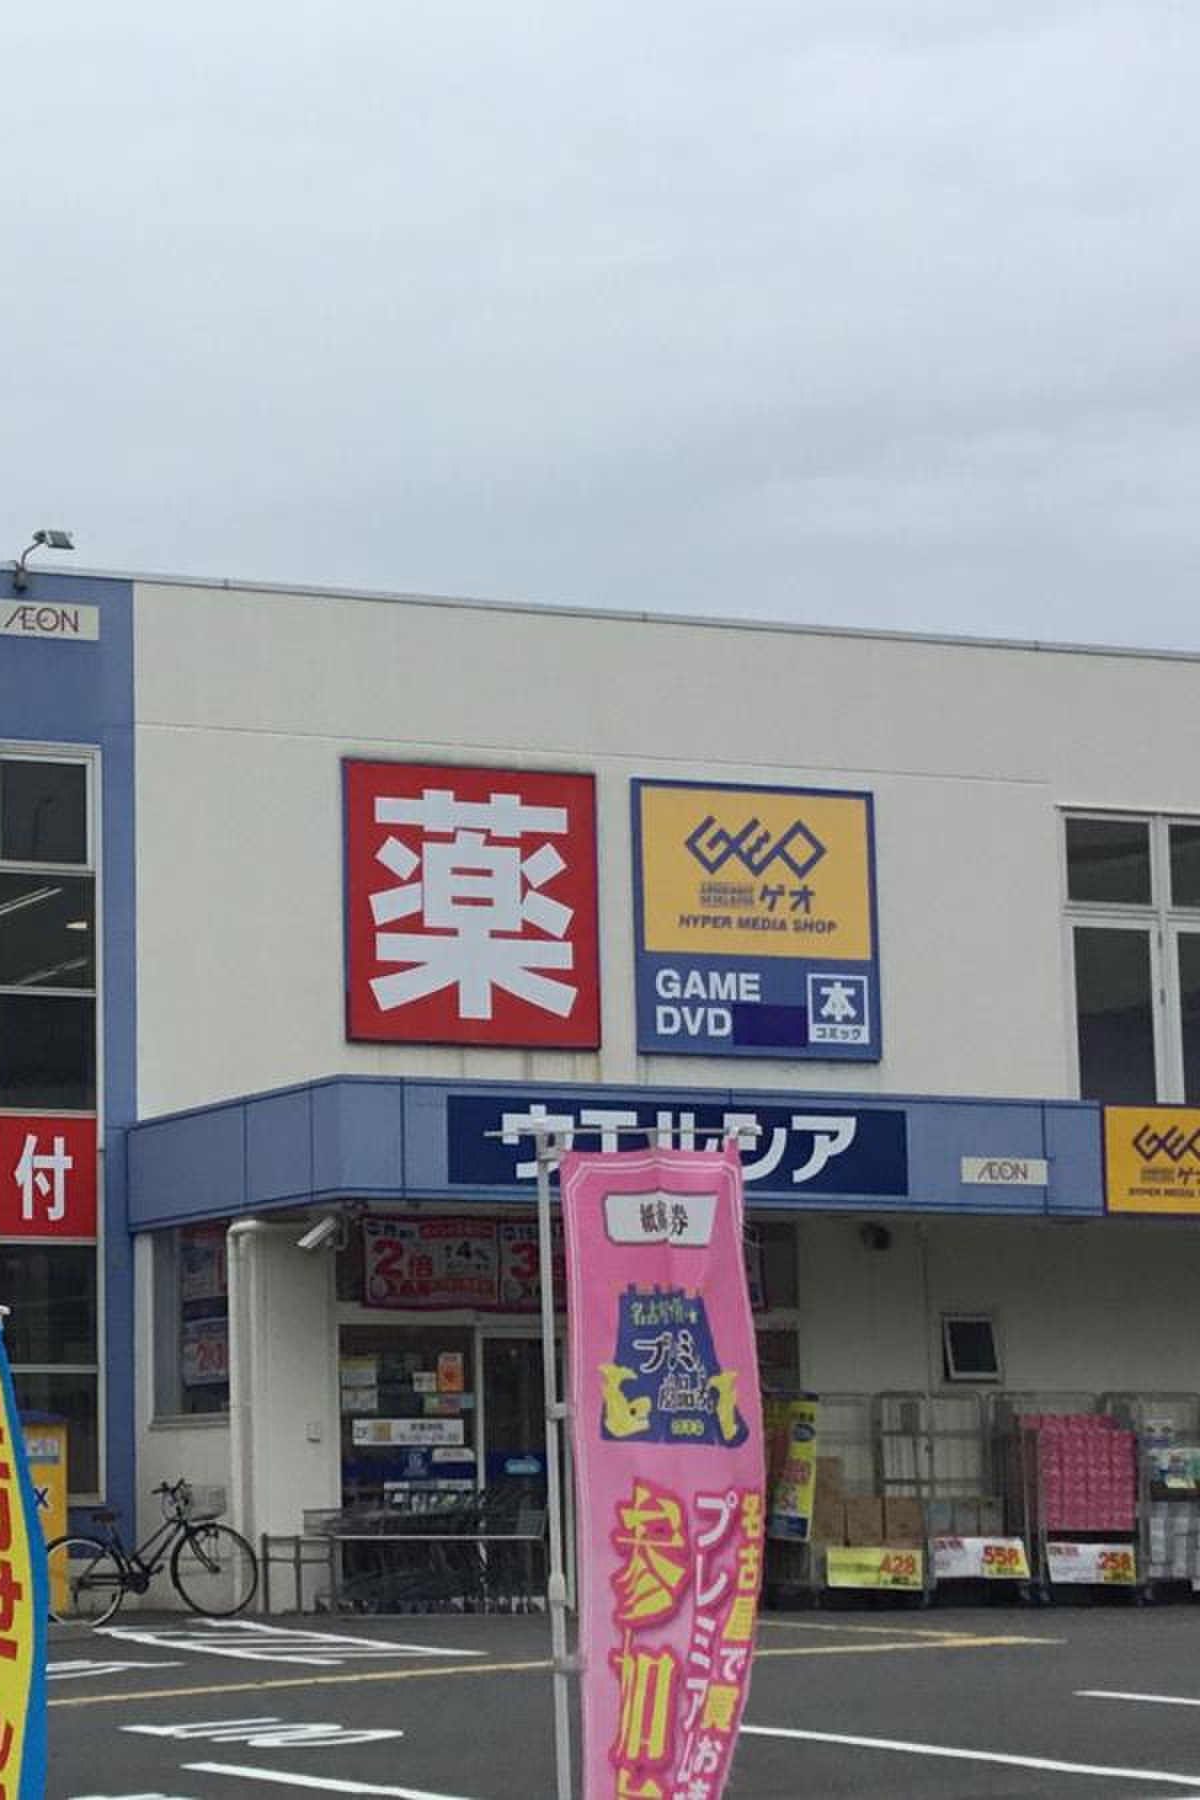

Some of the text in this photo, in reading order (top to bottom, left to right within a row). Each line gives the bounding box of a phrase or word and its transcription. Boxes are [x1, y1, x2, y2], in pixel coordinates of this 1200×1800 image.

[684, 815, 827, 879] GEO
[369, 789, 577, 1020] 薬
[759, 884, 816, 914] ゲオ
[678, 913, 838, 935] HYPER MEDIA SHOP
[655, 968, 762, 1002] GAME
[820, 981, 858, 1022] 本
[656, 1005, 733, 1037] DVD
[815, 1027, 863, 1040] コミック
